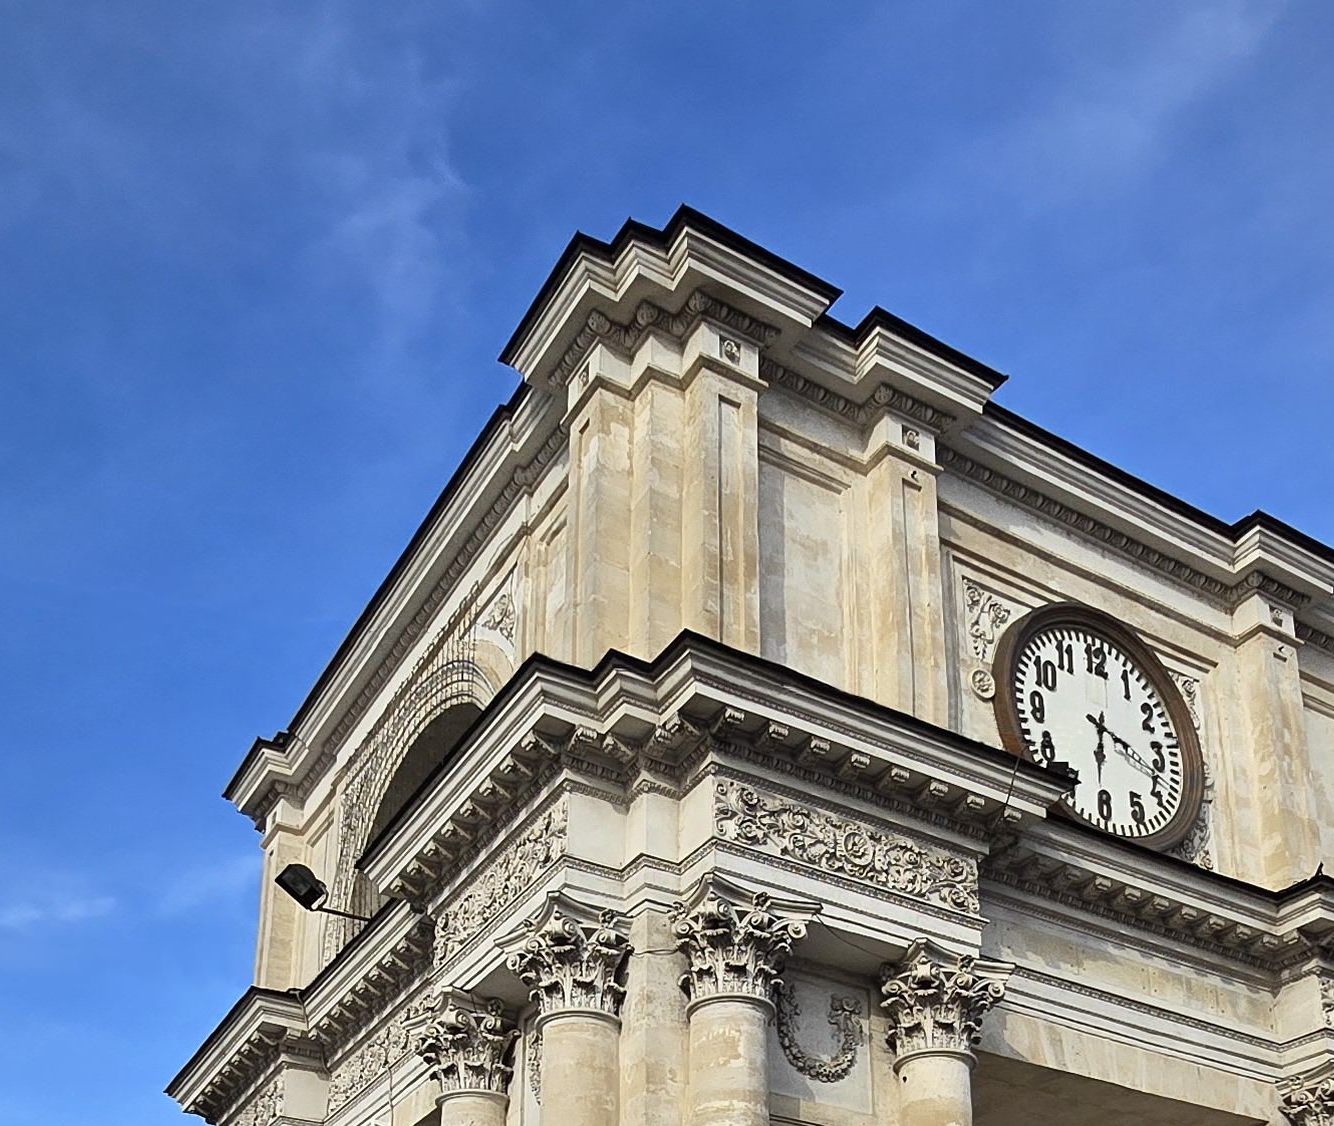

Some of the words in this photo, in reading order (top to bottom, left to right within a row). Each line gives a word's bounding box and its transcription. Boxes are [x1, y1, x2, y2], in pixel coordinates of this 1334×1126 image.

[1055, 640, 1074, 674] 11
[1084, 643, 1109, 680] 12
[1033, 655, 1057, 692] 10
[1121, 669, 1131, 700] 1
[1030, 690, 1045, 723] 9
[1141, 702, 1155, 734] 2
[1041, 730, 1055, 761] 8
[1150, 741, 1165, 773] 3
[1098, 789, 1112, 821] 6
[1150, 773, 1163, 807] 4
[1129, 791, 1145, 823] 5
